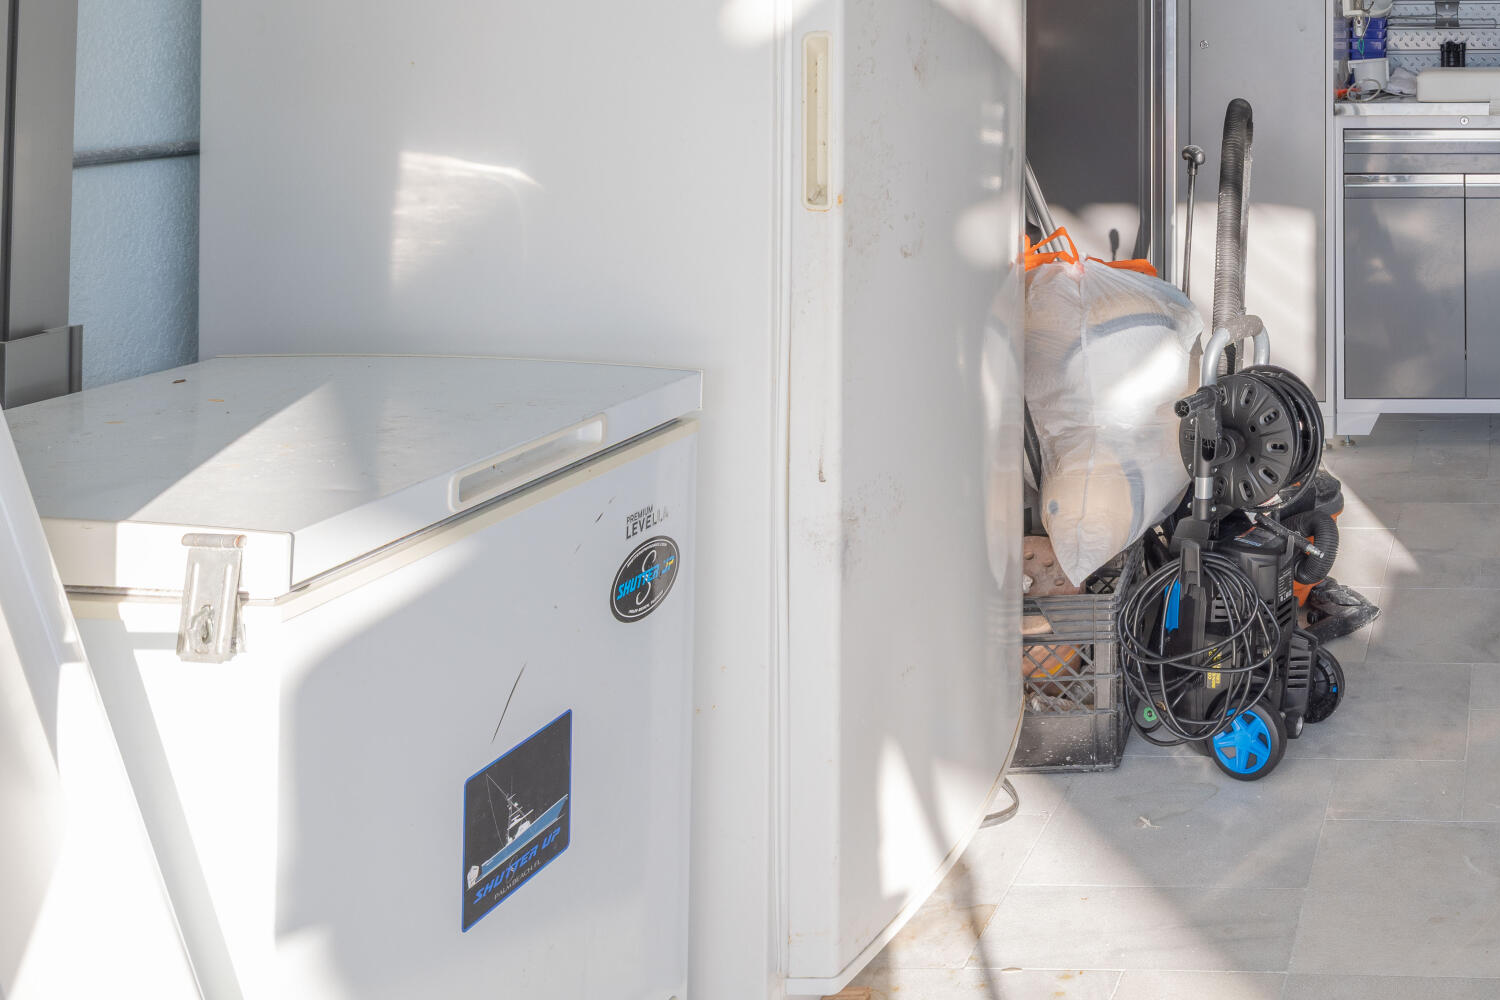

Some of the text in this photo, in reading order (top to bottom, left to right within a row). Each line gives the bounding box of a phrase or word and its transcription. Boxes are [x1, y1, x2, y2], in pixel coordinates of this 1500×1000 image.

[626, 504, 654, 525] PREMIUM
[616, 563, 660, 601] SHUTTER
[661, 555, 675, 575] UP
[473, 826, 561, 905] SHUTTER UP
[494, 882, 512, 900] PALM
